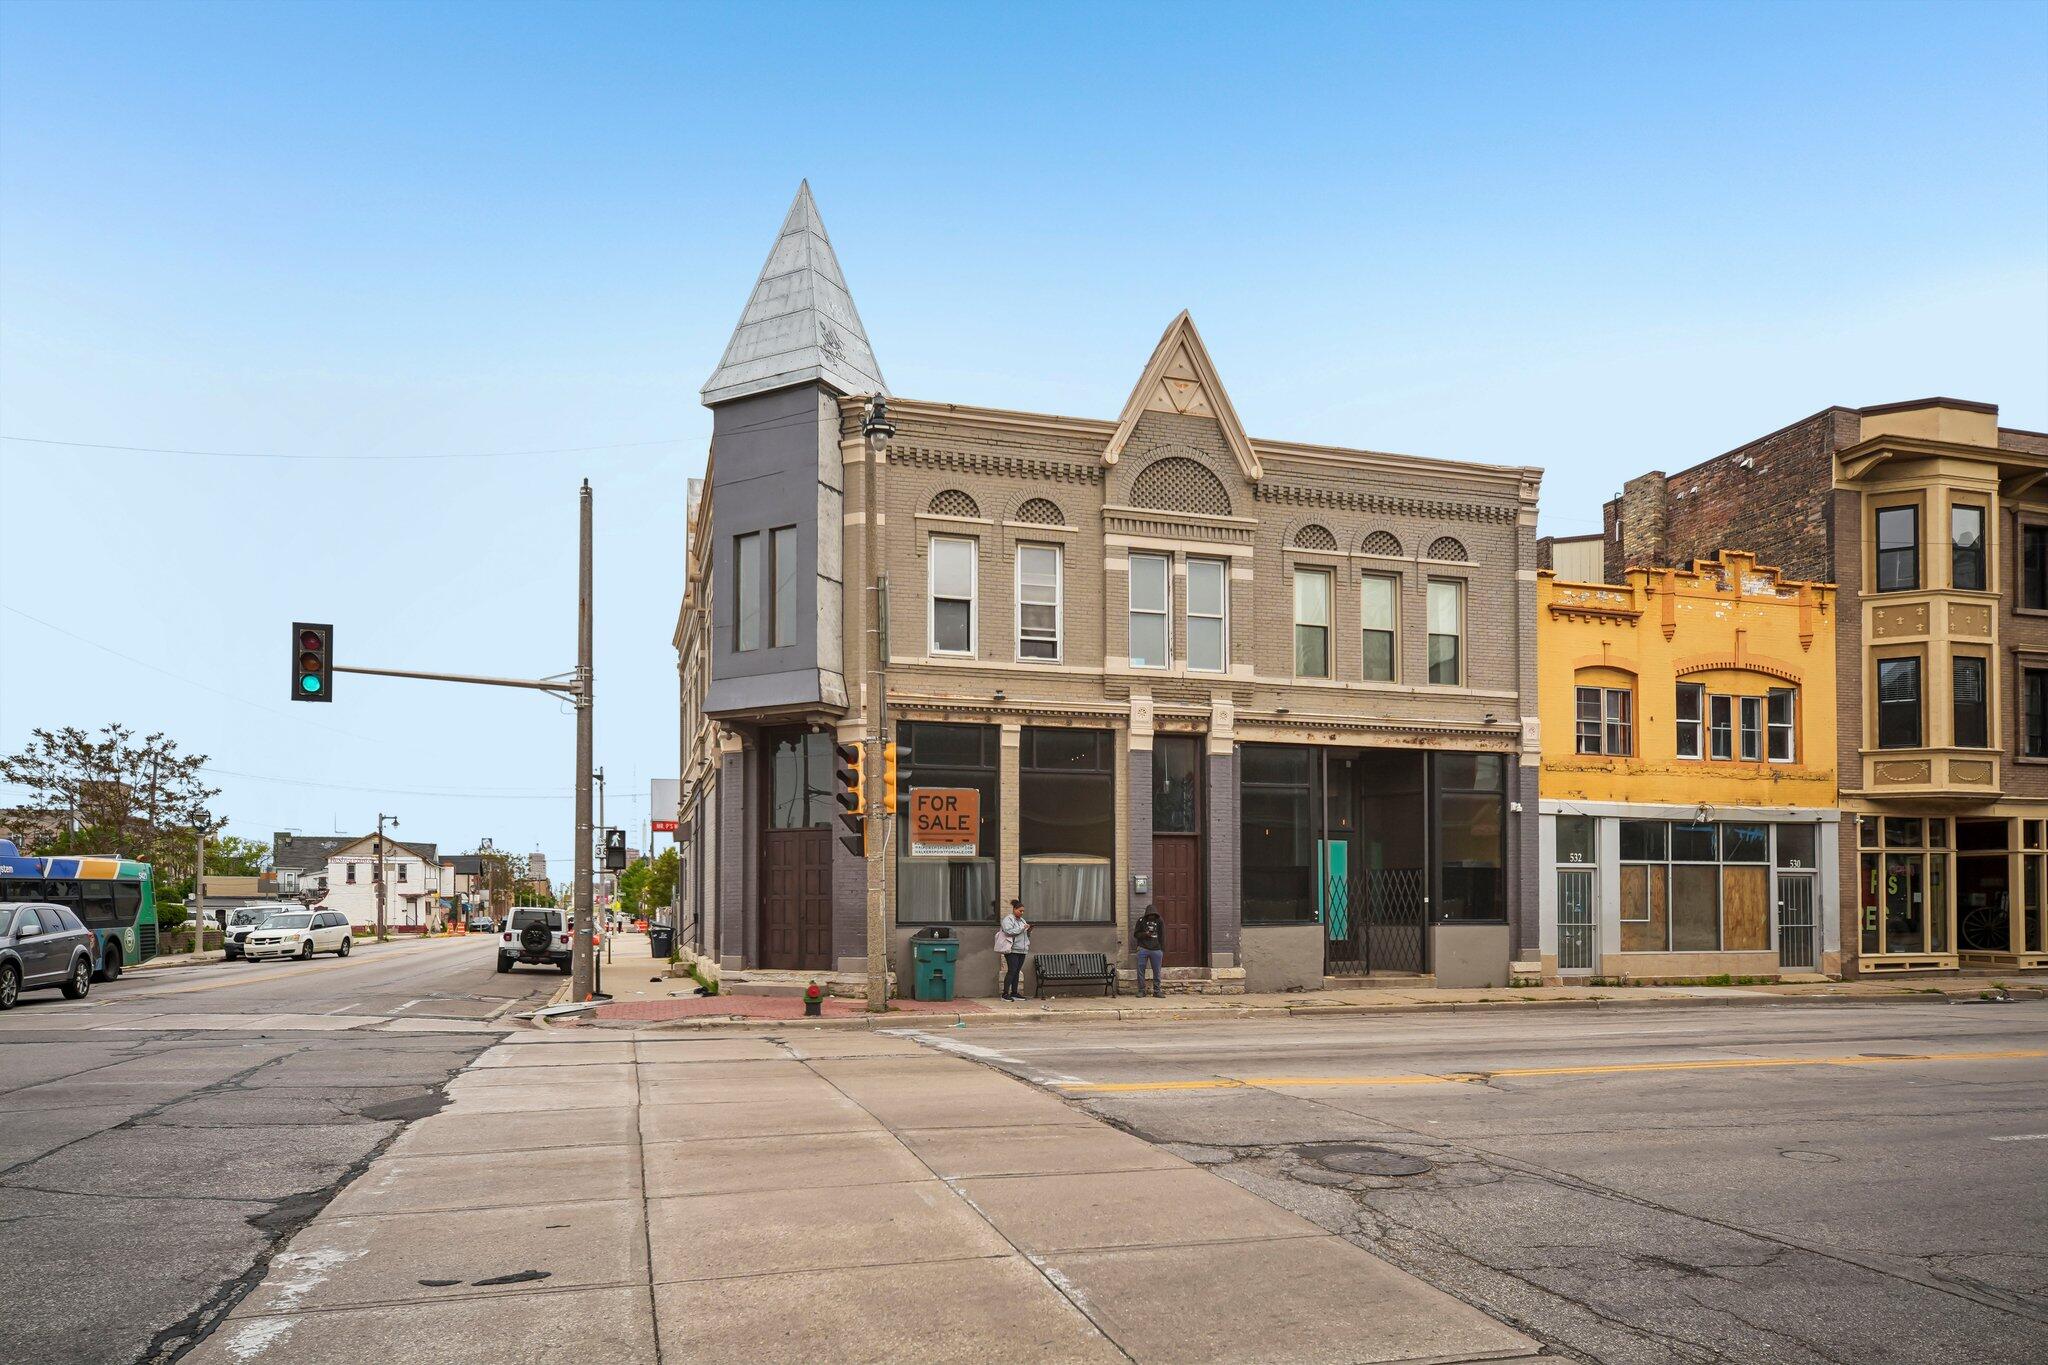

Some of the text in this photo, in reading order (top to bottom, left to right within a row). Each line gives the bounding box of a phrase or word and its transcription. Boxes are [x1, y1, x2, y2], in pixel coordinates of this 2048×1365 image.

[918, 795, 958, 812] FOR
[918, 814, 970, 831] SALE
[1569, 852, 1582, 863] 532
[1789, 859, 1801, 868] 530
